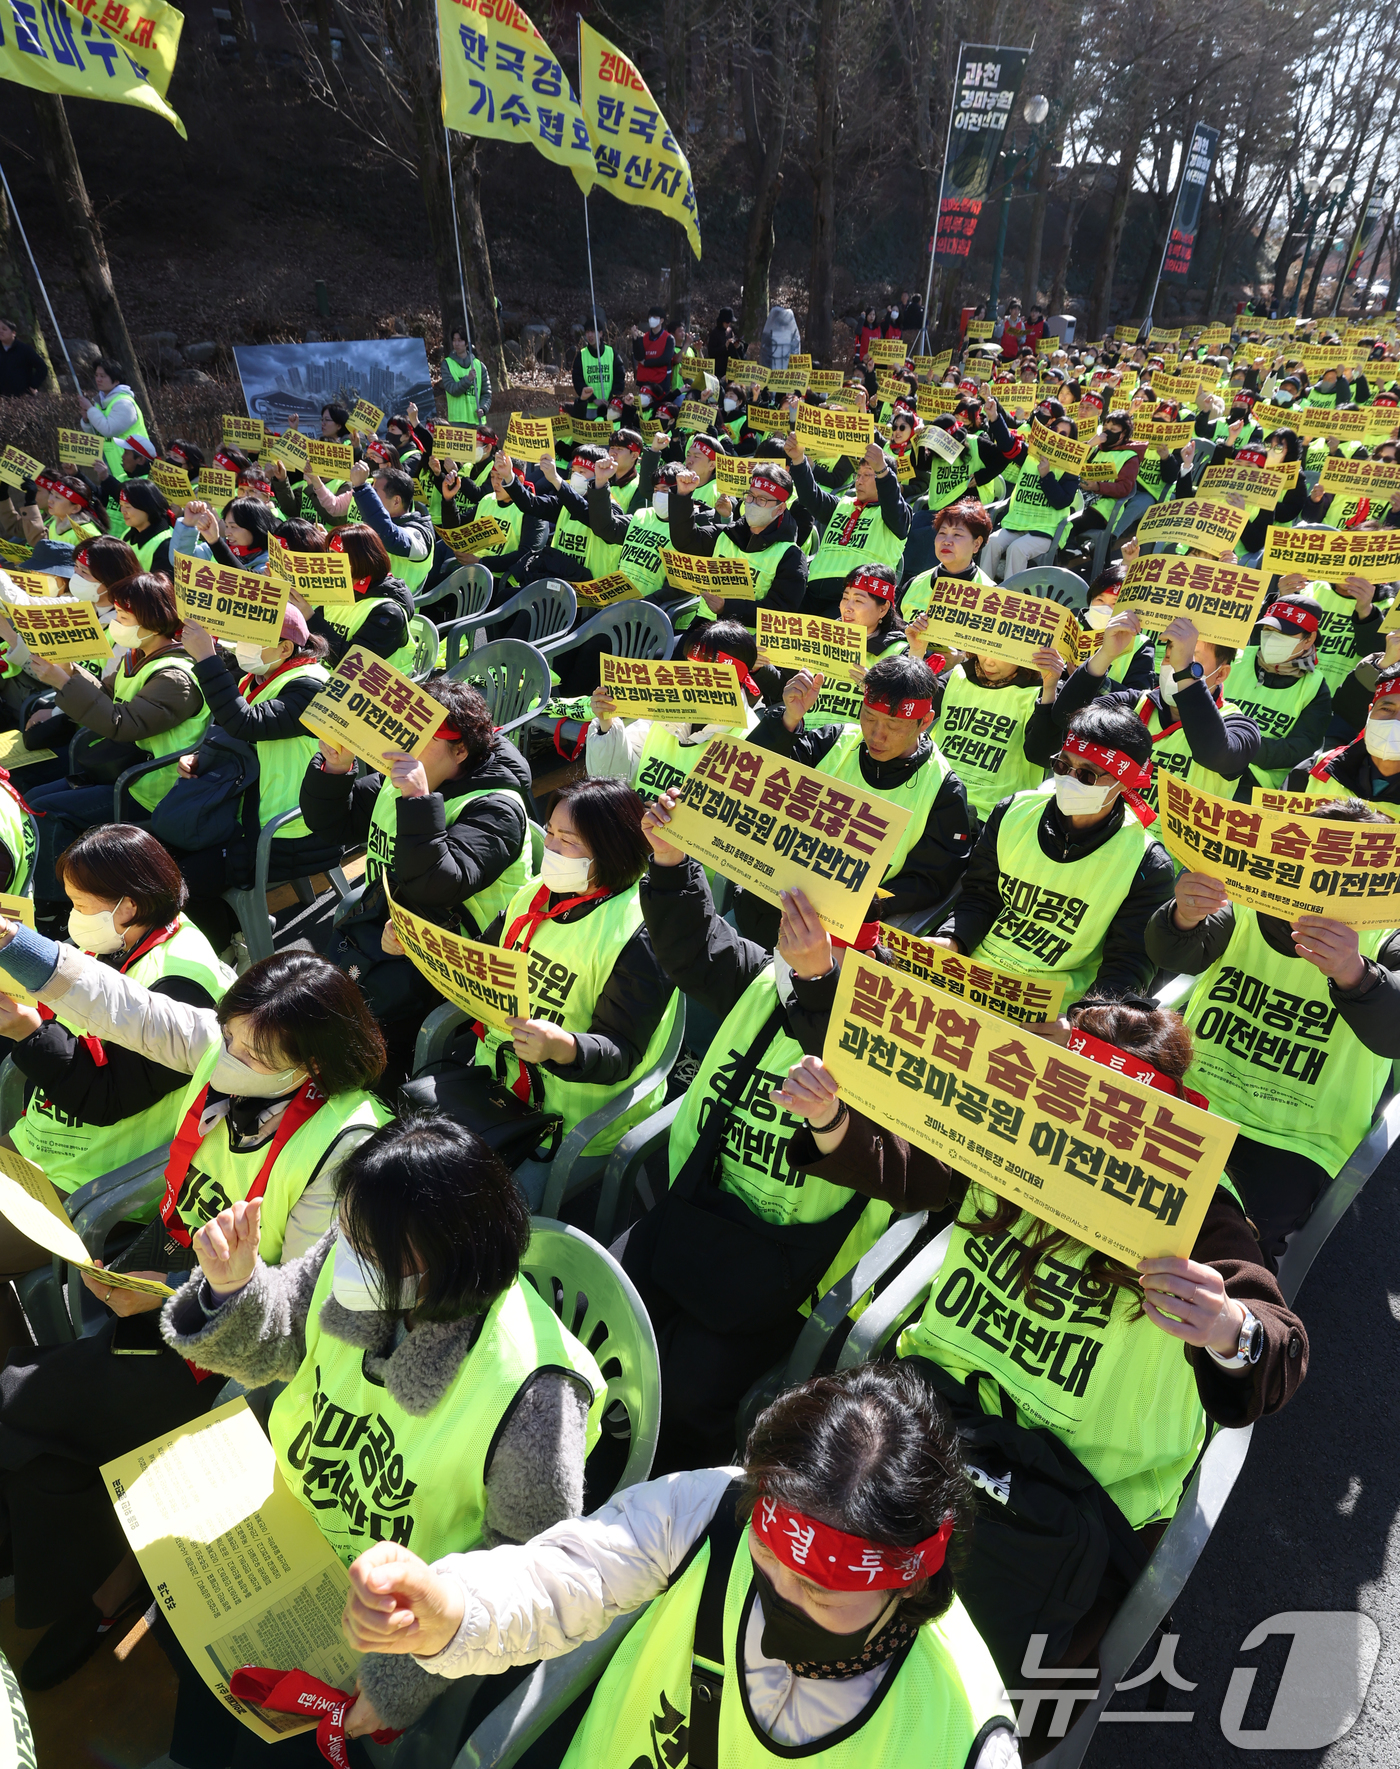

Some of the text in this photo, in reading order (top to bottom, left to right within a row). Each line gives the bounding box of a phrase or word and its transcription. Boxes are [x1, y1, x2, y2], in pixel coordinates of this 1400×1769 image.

[459, 23, 579, 103] 한국경
[963, 62, 1001, 88] 과천
[960, 90, 1014, 110] 경마공원
[955, 111, 1008, 132] 이전반대
[509, 420, 548, 437] 숨통끊는
[824, 410, 870, 432] 숨통끊는
[838, 430, 870, 445] 이전반대
[1208, 467, 1282, 488] 말산업 숨통끊는
[1327, 460, 1360, 475] 말산업
[1246, 482, 1277, 498] 이전반대
[1148, 500, 1243, 529] 말산업 숨통끊는
[1196, 519, 1237, 543] 이전반대
[1273, 530, 1326, 549] 말산업
[283, 555, 344, 576] 숨통끊는
[663, 550, 745, 575] 말산업 숨통끊는
[1269, 547, 1346, 566] 과천경마공원
[195, 565, 282, 606] 숨통끊는
[299, 576, 347, 589] 이전반대
[713, 575, 749, 586] 이전반대
[1124, 558, 1261, 601] 말산업 숨통끊는
[12, 606, 92, 630] 숨통끊는
[216, 597, 279, 625] 이전반대
[933, 581, 1060, 630] 말산업 숨통끊는
[1185, 594, 1254, 624] 이전반대
[39, 627, 99, 647] 이전반대
[760, 612, 861, 648] 말산업 숨통끊는
[999, 620, 1054, 648] 이전반대
[759, 634, 861, 665] 과천경마공원 이전반대
[603, 659, 733, 689] 말산업 숨통끊는
[335, 652, 435, 732] 숨통끊는
[683, 689, 738, 707] 이전반대
[349, 692, 420, 753] 이전반대
[944, 705, 1018, 744] 경마공원
[694, 740, 890, 856] 말산업 숨통끊는
[1167, 780, 1263, 848] 말산업
[679, 778, 777, 846] 과천경마공원
[773, 823, 871, 892] 이전반대
[1167, 812, 1305, 890] 과천경마공원
[1000, 872, 1089, 935] 경마공원
[1225, 877, 1324, 915] 경마노동자 총력투쟁 결의대회
[421, 926, 518, 990] 숨통끊는
[452, 969, 519, 1018] 이전반대
[941, 958, 1052, 1007] 숨통끊는
[1208, 966, 1339, 1044] 경마공원
[1195, 1006, 1329, 1086] 이전반대
[851, 966, 1205, 1181] 말산업 숨통끊는
[838, 1019, 1026, 1145] 과천경마공원
[1029, 1121, 1188, 1227] 이전반대
[923, 1114, 1044, 1190] 경마노동자 총력투쟁 결의대회
[935, 1267, 1104, 1398] 이전반대
[157, 1581, 177, 1610] 주요 구호
[215, 1680, 228, 1696] 순서
